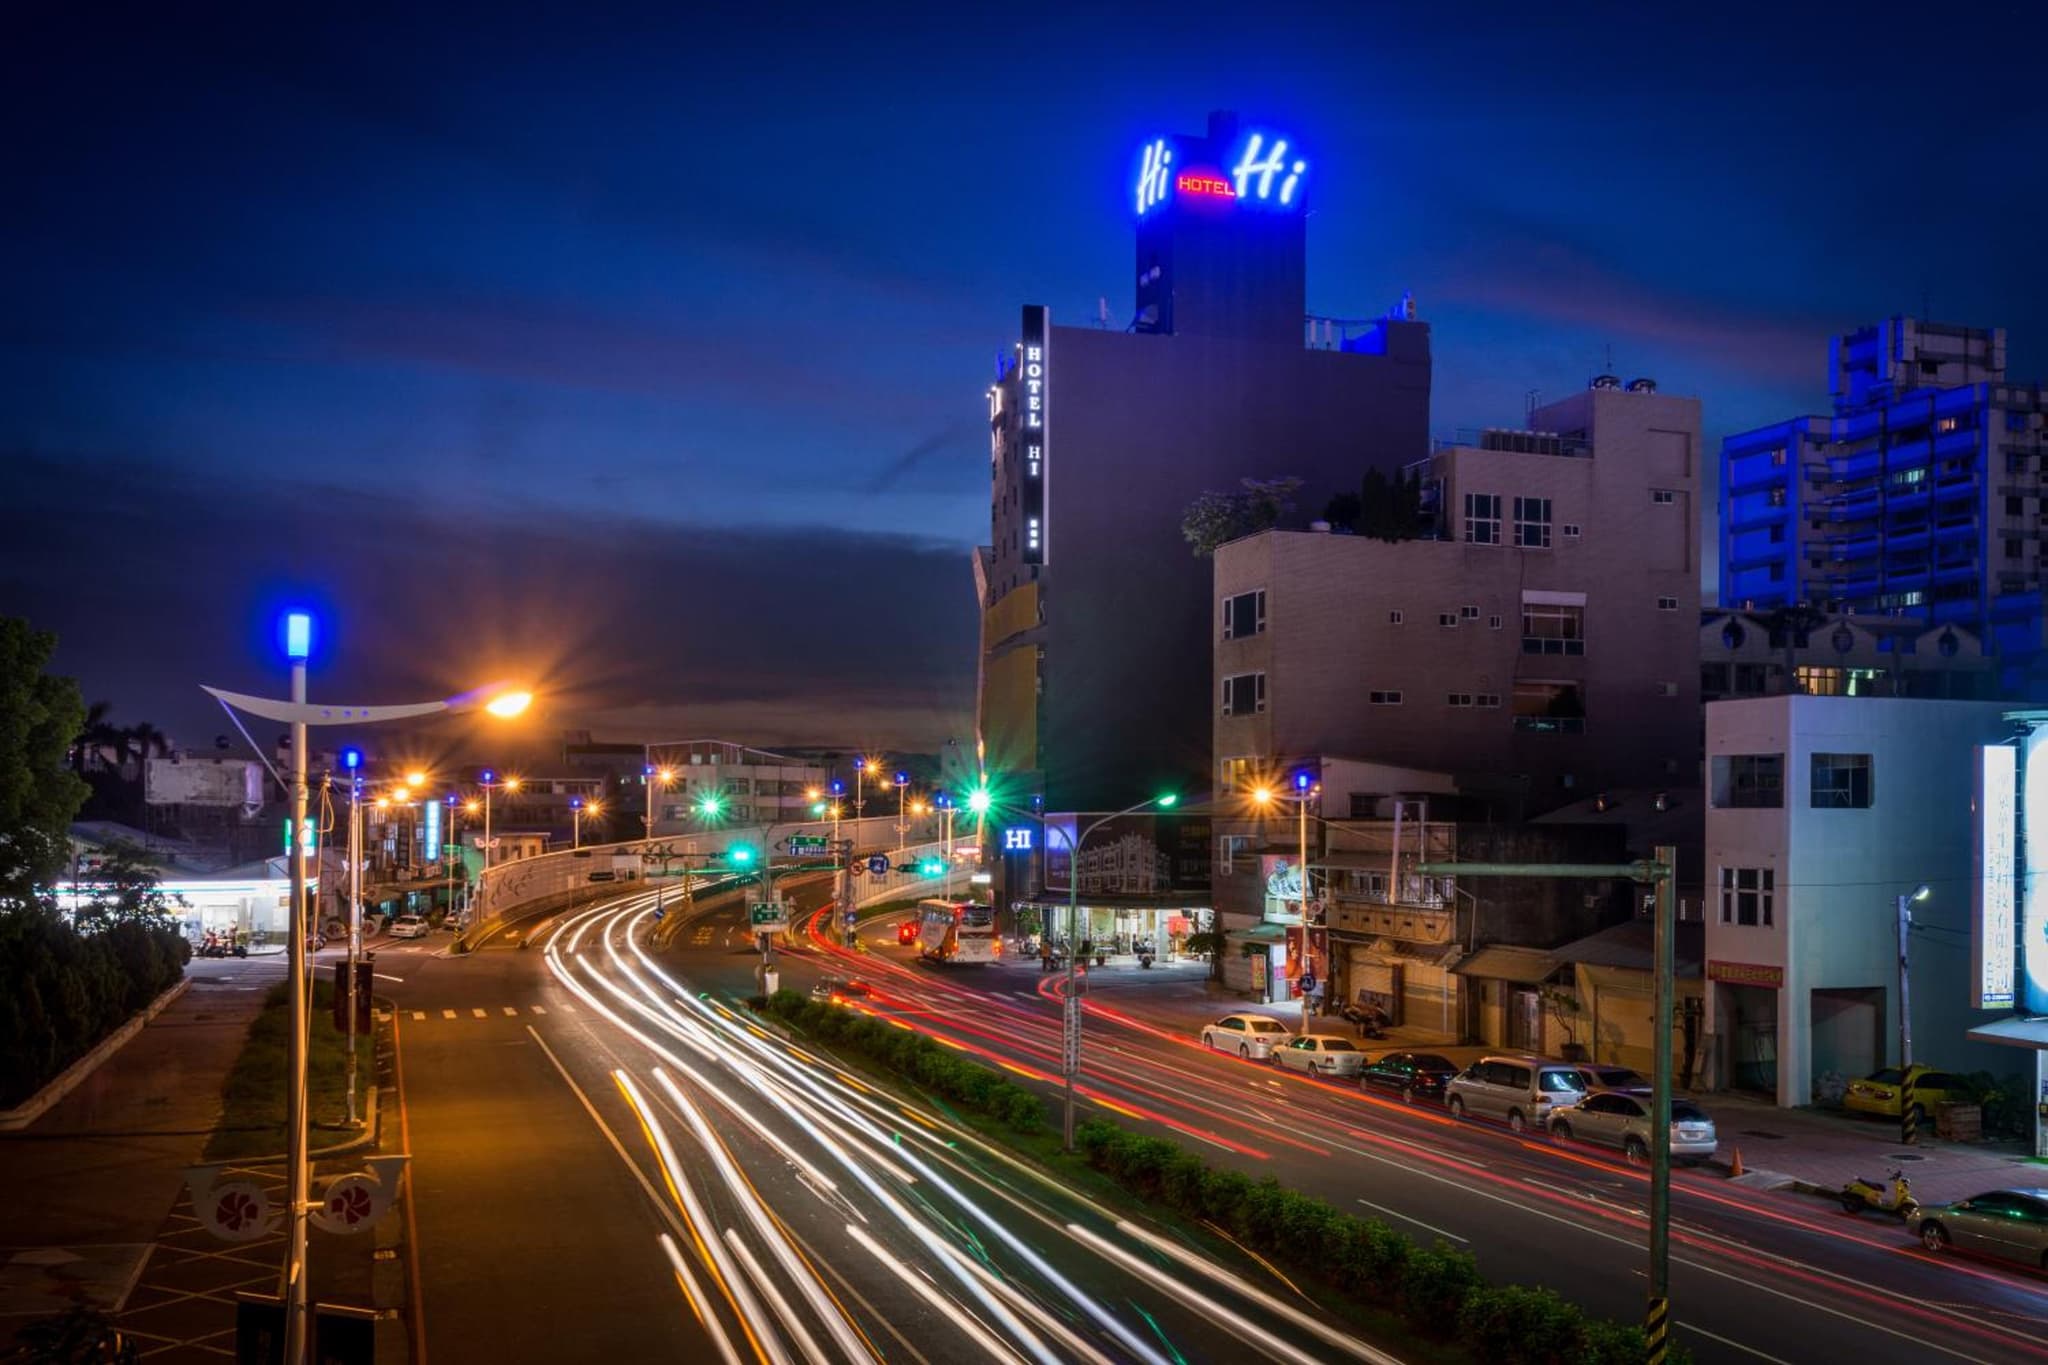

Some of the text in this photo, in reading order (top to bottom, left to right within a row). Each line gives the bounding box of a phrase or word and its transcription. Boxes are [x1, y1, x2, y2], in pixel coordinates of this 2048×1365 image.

[1136, 138, 1172, 215] Hi
[1178, 133, 1306, 205] HOTEL Hi
[1027, 347, 1042, 476] HOTEL HI
[1005, 829, 1032, 849] HI
